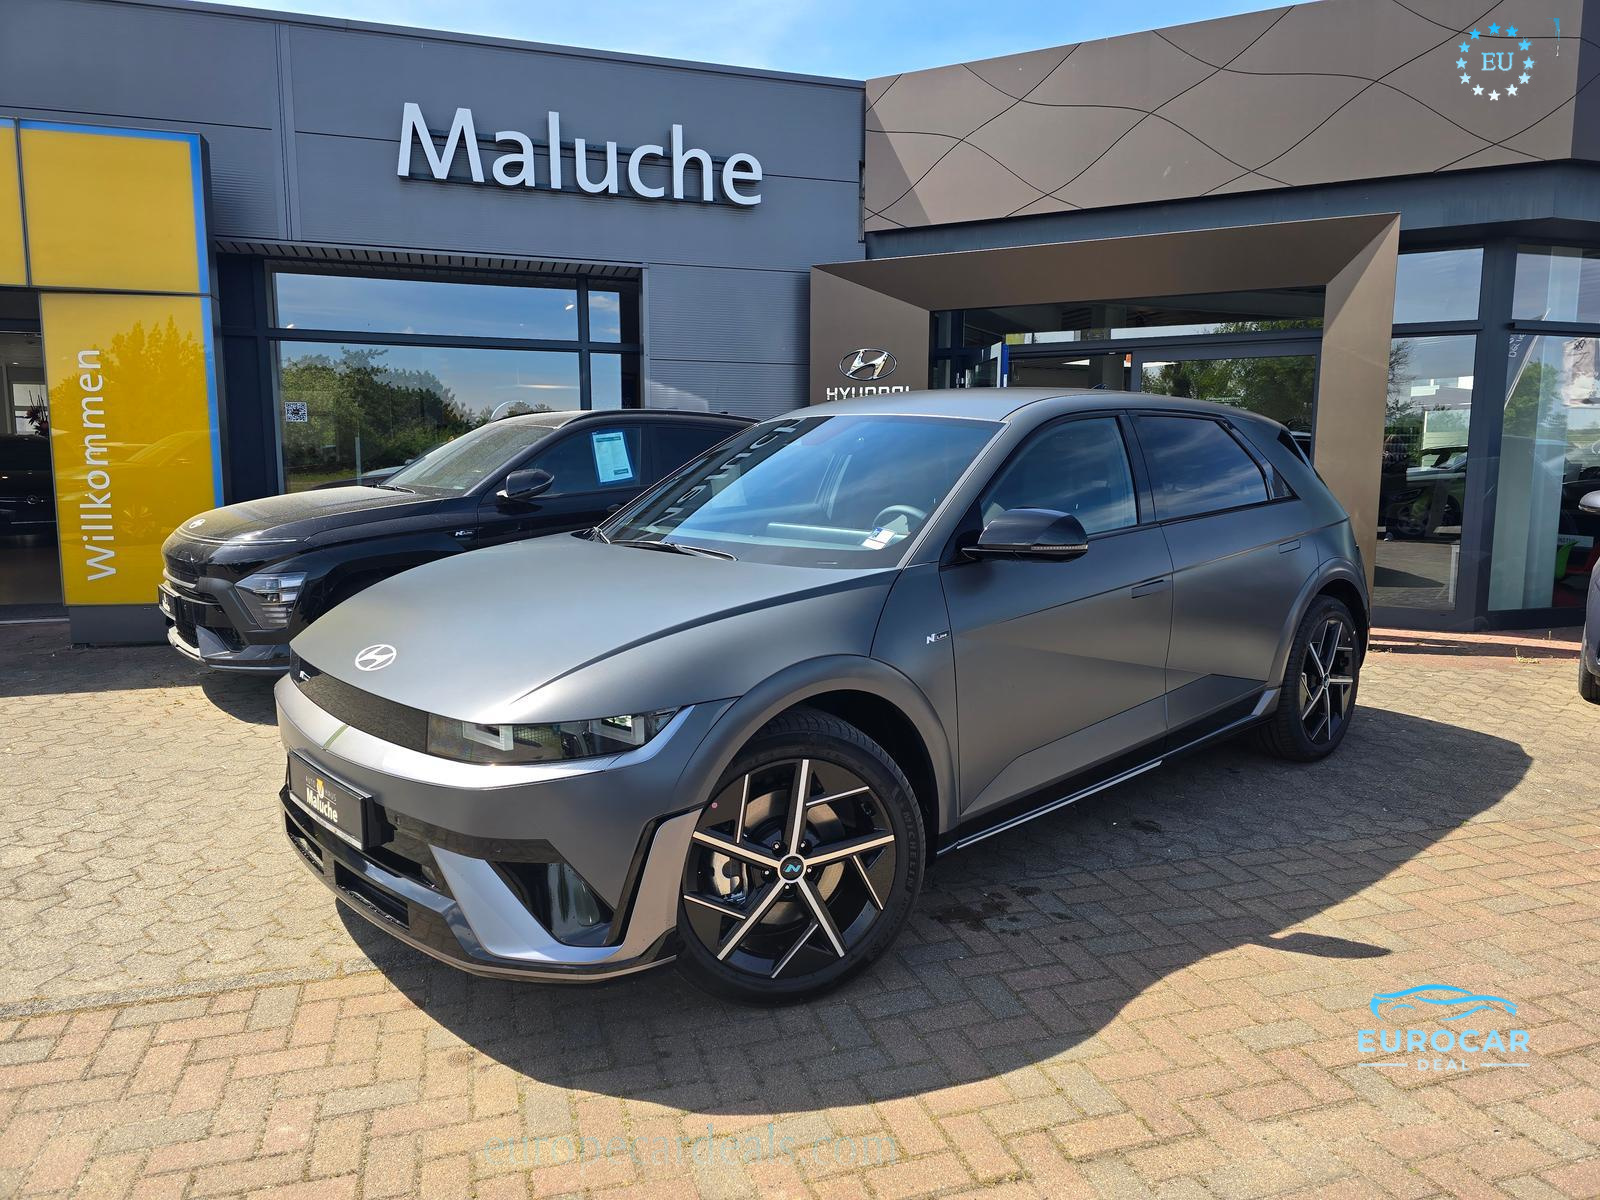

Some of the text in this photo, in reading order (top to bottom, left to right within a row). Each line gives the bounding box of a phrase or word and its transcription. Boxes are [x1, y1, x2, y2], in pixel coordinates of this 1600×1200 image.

[397, 102, 763, 206] Maluche
[76, 348, 117, 581] Willkommen
[306, 787, 338, 823] Maluche
